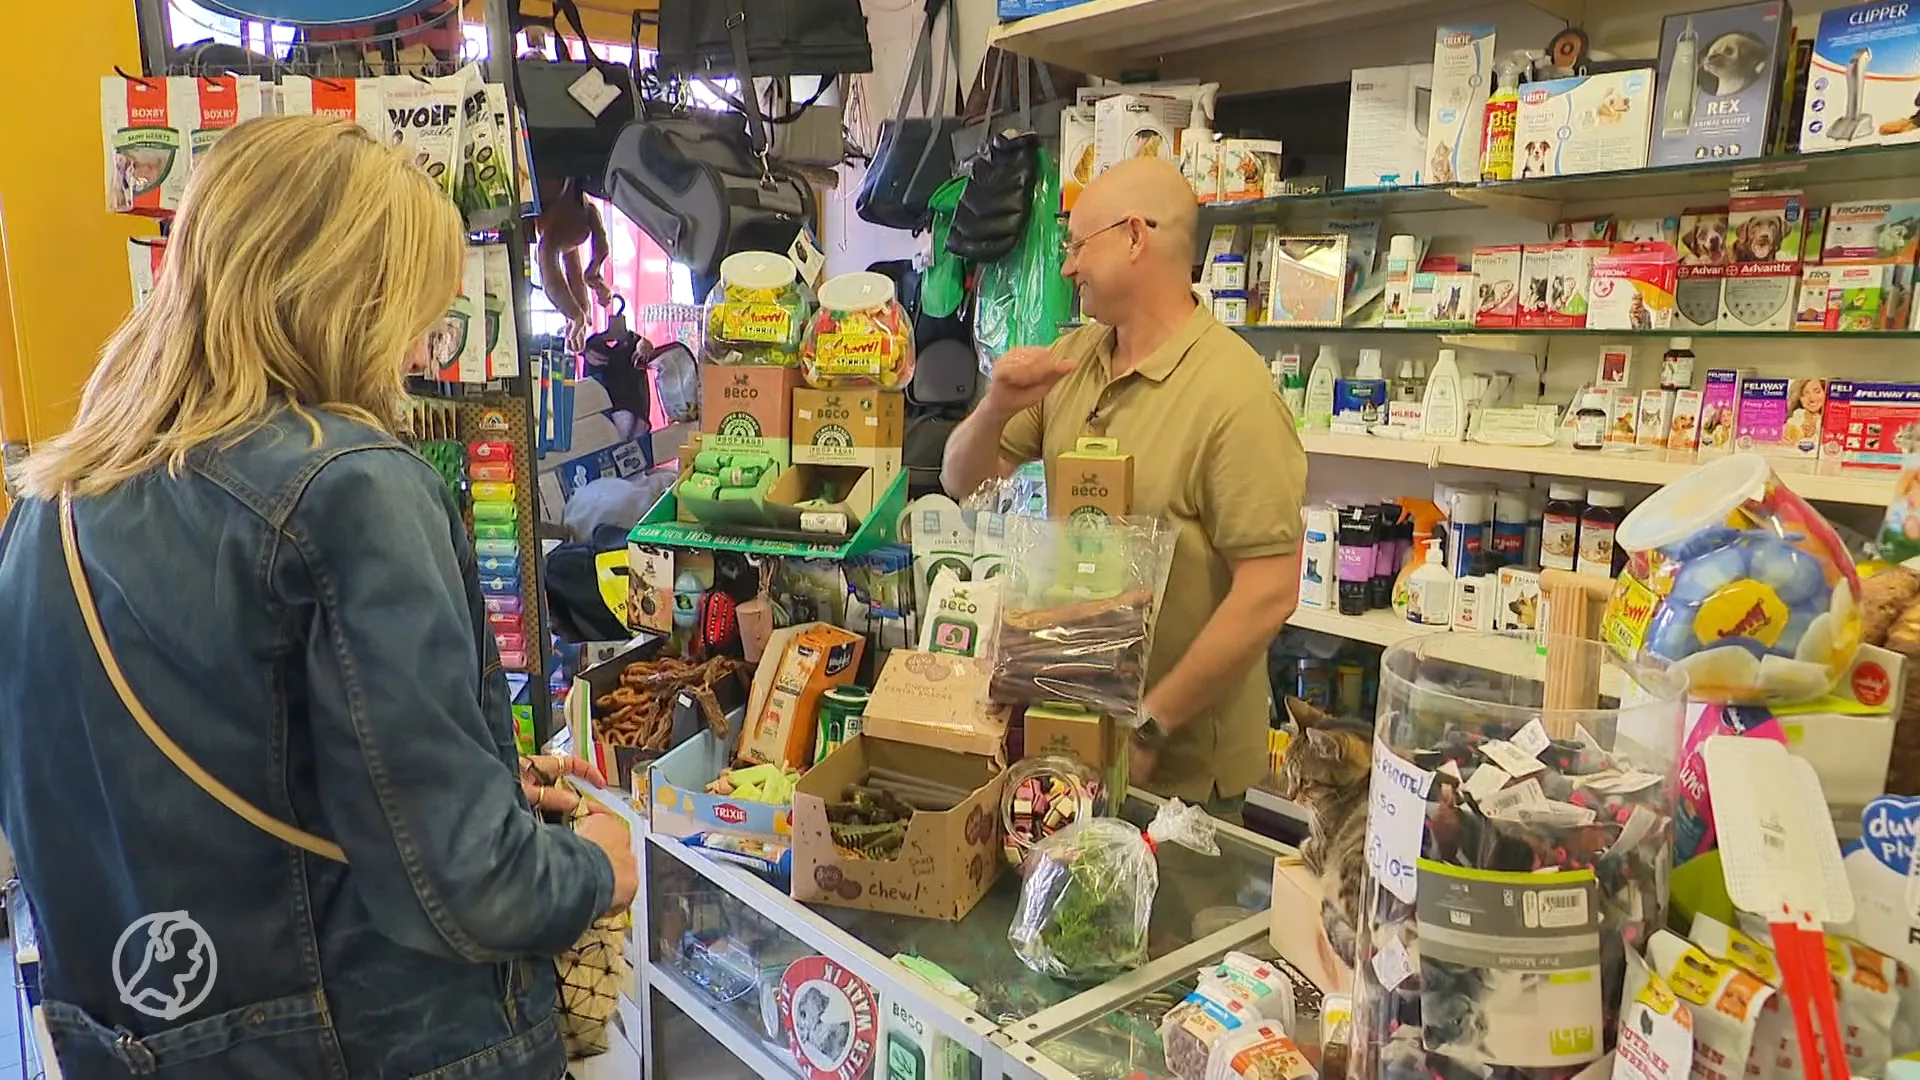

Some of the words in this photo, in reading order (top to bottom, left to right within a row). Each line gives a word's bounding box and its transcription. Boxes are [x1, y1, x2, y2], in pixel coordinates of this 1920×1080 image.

[1849, 3, 1909, 26] CLIPPER
[131, 107, 165, 118] BOXBY
[203, 108, 236, 120] BOXBY
[1707, 99, 1741, 115] REX
[388, 104, 457, 129] WOEF
[1837, 204, 1892, 214] FRONTPRO
[1741, 262, 1792, 273] Advantix
[1744, 382, 1786, 391] FELIWAY
[1830, 384, 1853, 393] FELI
[713, 806, 746, 820] TRIXIE
[822, 963, 842, 985] IK
[842, 978, 874, 1033] WAAK
[837, 1038, 871, 1080] HIER
